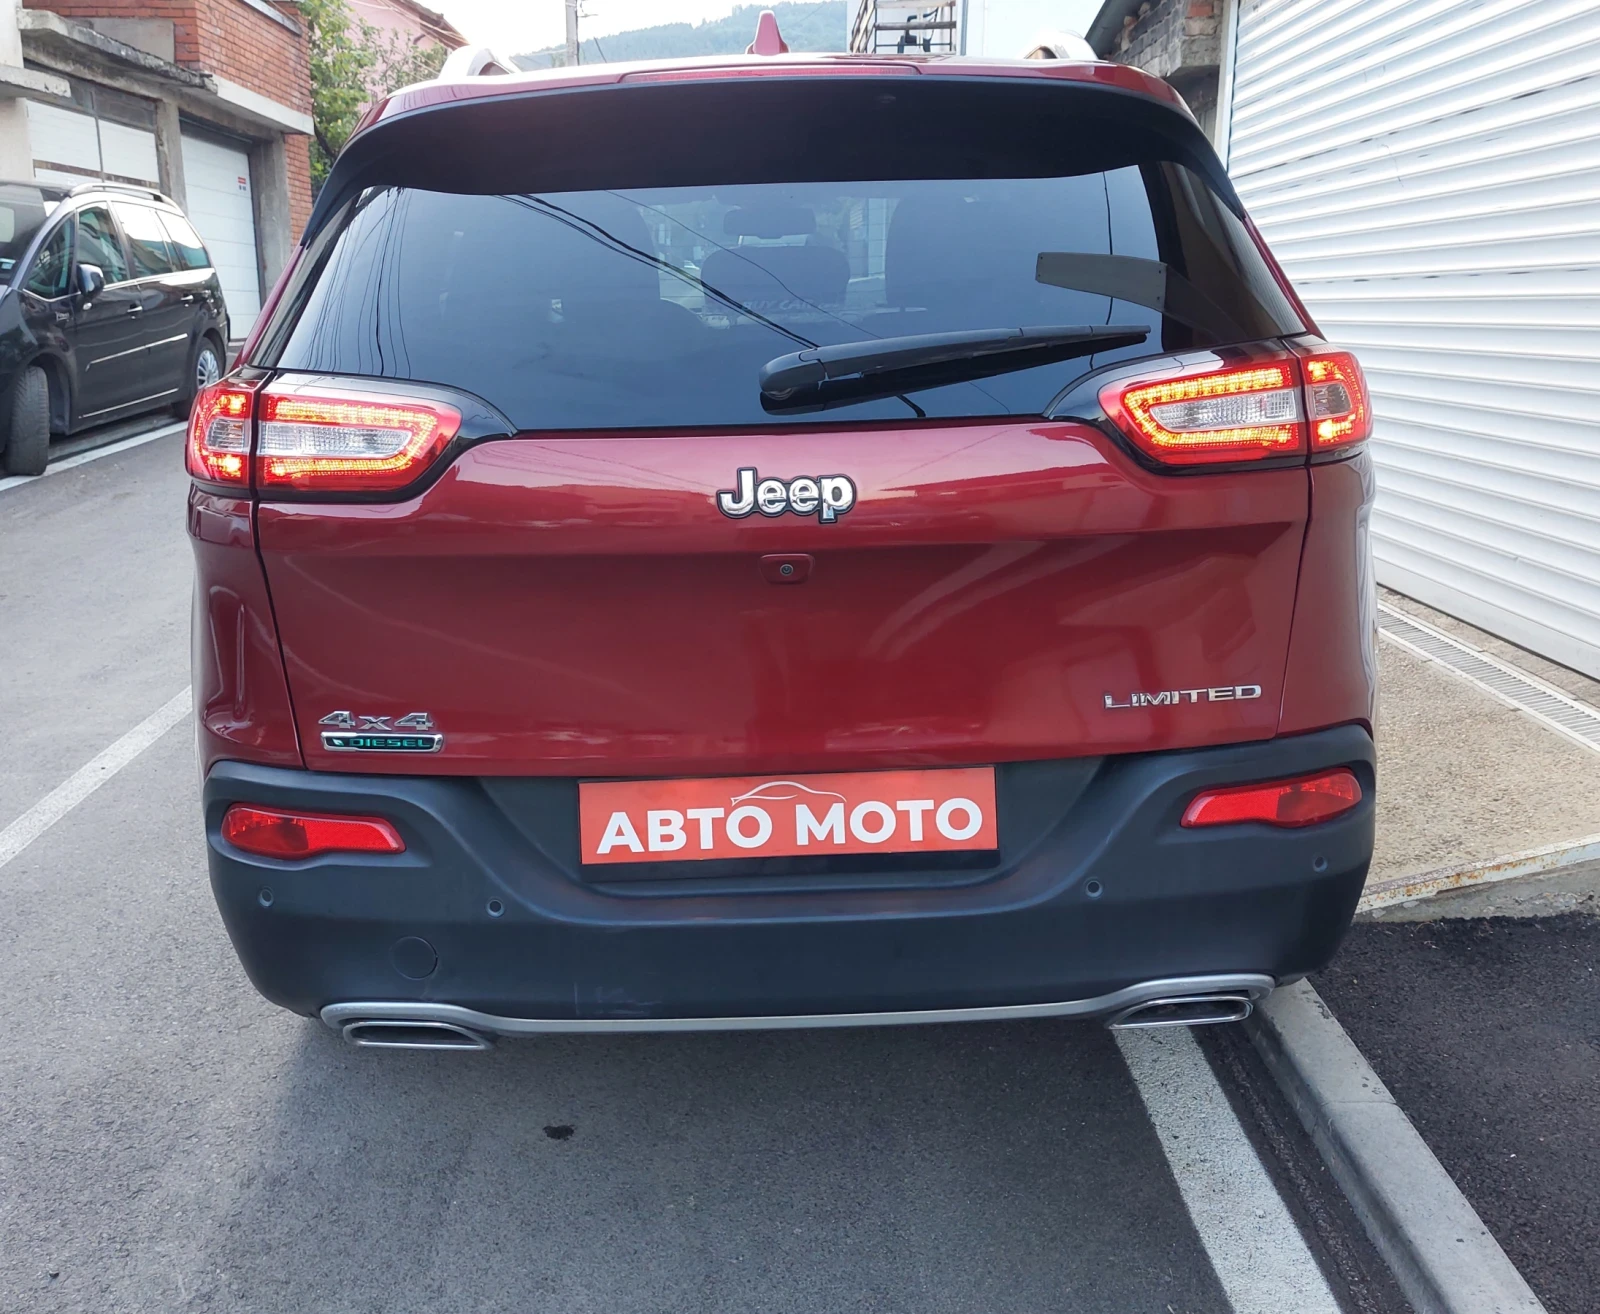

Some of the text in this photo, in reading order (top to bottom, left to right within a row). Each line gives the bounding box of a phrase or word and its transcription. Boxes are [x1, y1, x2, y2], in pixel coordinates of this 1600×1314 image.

[718, 468, 855, 521] Jeep
[1104, 684, 1262, 709] LIMITED
[318, 710, 434, 731] 4x4
[350, 737, 431, 747] DIESEL
[596, 797, 983, 854] АВТО МОТО
